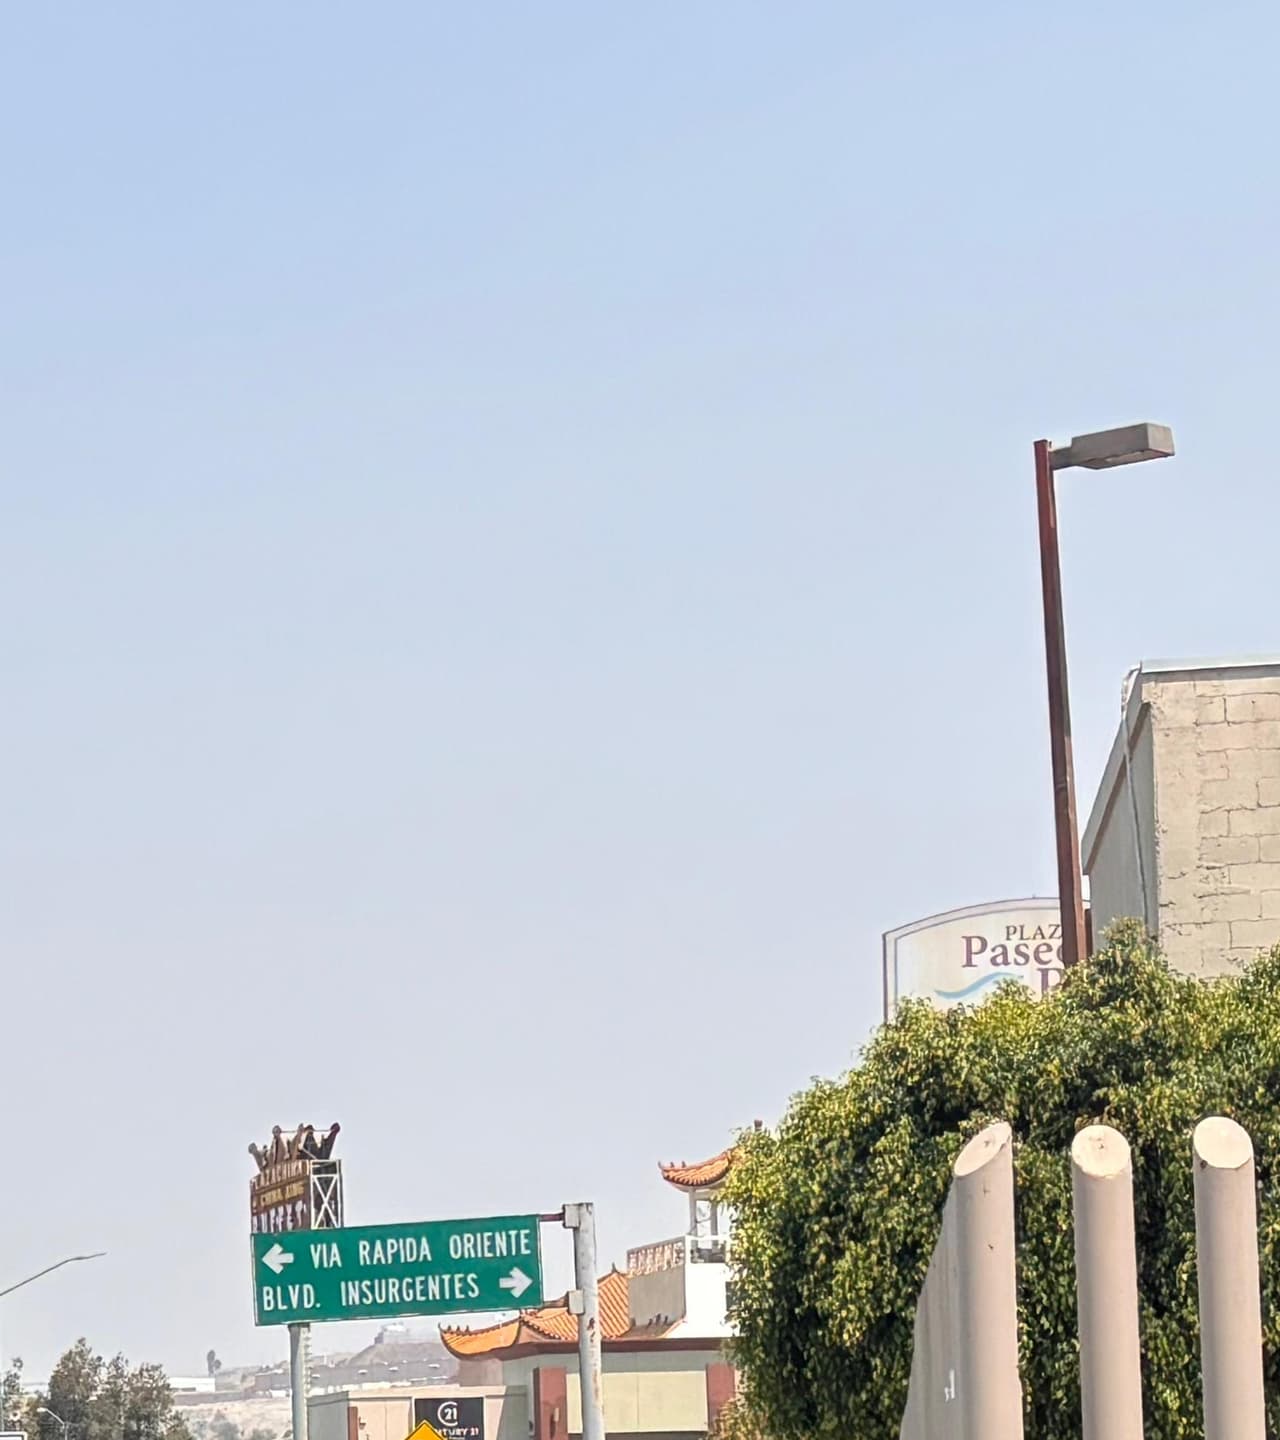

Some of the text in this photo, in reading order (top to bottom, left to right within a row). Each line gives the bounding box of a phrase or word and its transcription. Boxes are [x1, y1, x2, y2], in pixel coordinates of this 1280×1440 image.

[1005, 924, 1062, 941] PLAZ
[960, 935, 1063, 968] Pase
[309, 1229, 532, 1269] VIA RAPIDA ORIENTE
[262, 1273, 480, 1311] BLVD. INSURGENTES
